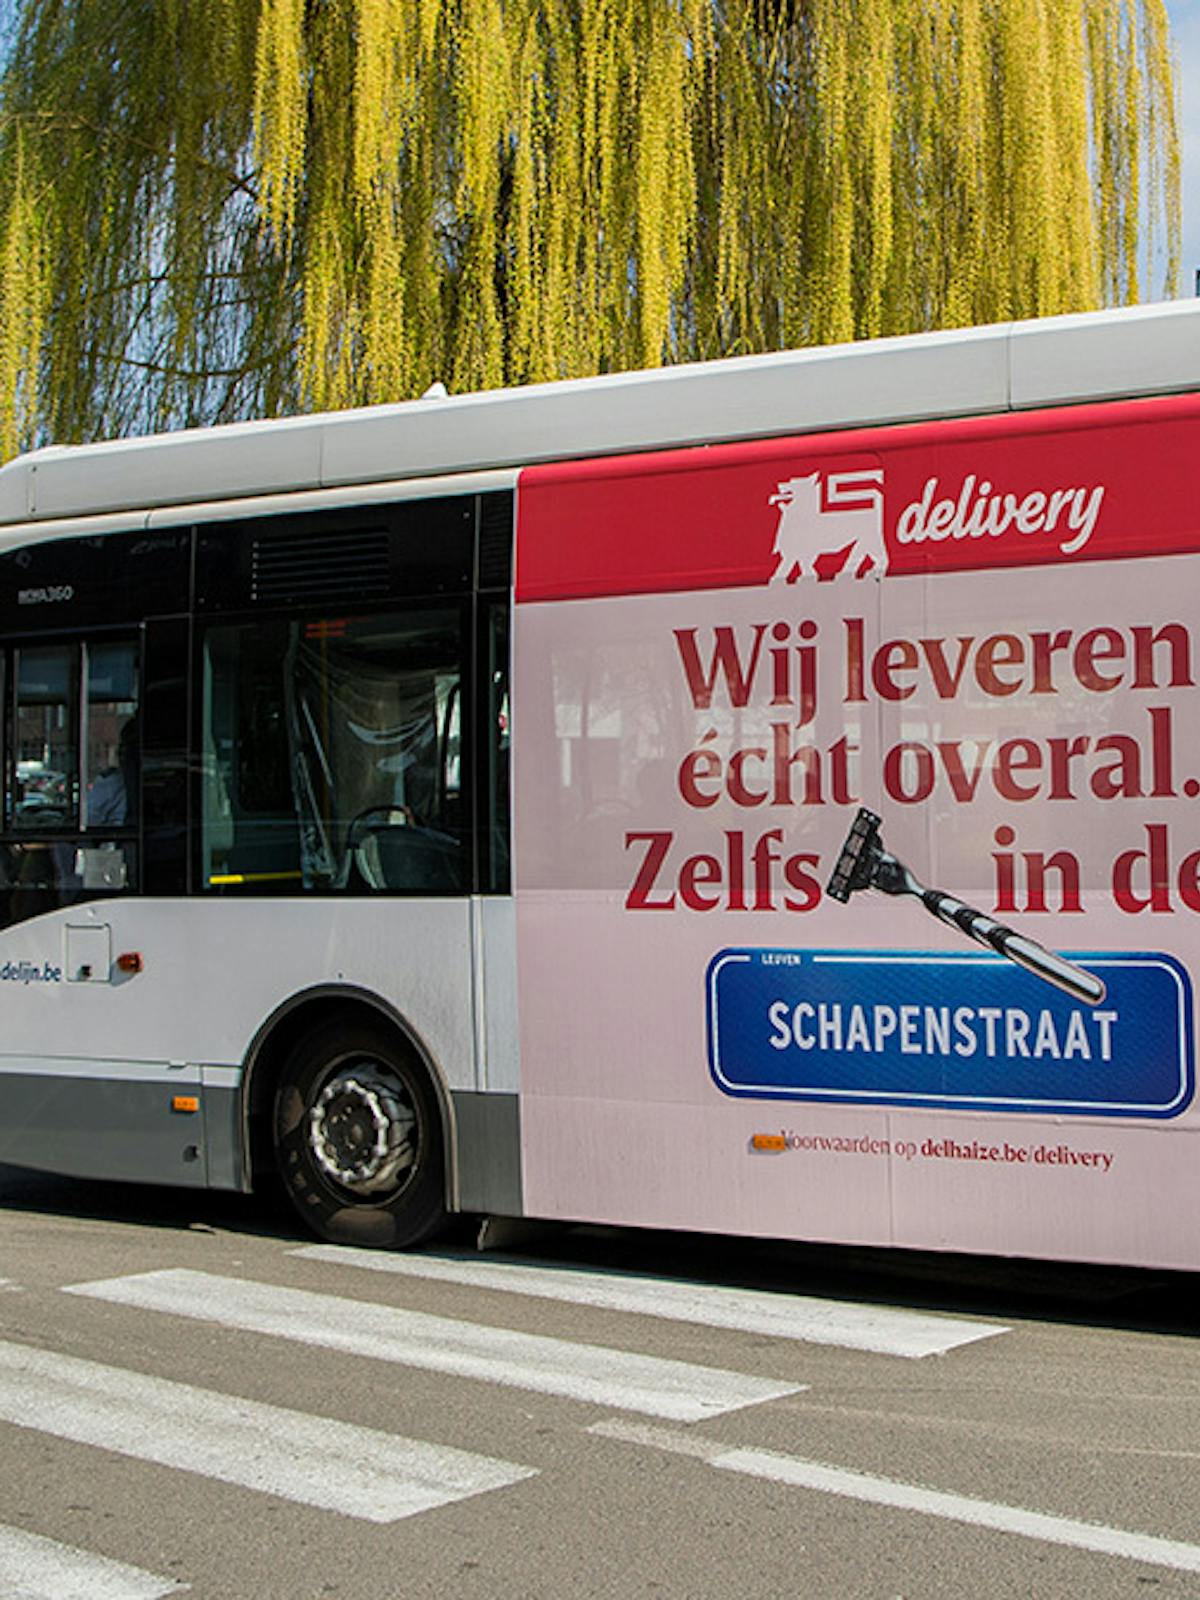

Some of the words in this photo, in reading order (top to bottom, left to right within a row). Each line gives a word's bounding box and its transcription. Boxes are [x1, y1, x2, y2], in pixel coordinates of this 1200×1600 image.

[899, 475, 1104, 553] delivery
[672, 619, 819, 729] Wij
[842, 617, 1197, 704] leveren
[677, 722, 861, 808] écht
[624, 828, 821, 912] Zelfs
[991, 825, 1086, 914] in
[768, 1001, 1119, 1060] SCHAPENSTRAAT
[894, 1142, 917, 1160] op
[920, 1138, 1115, 1172] delhaize.be/delivery
